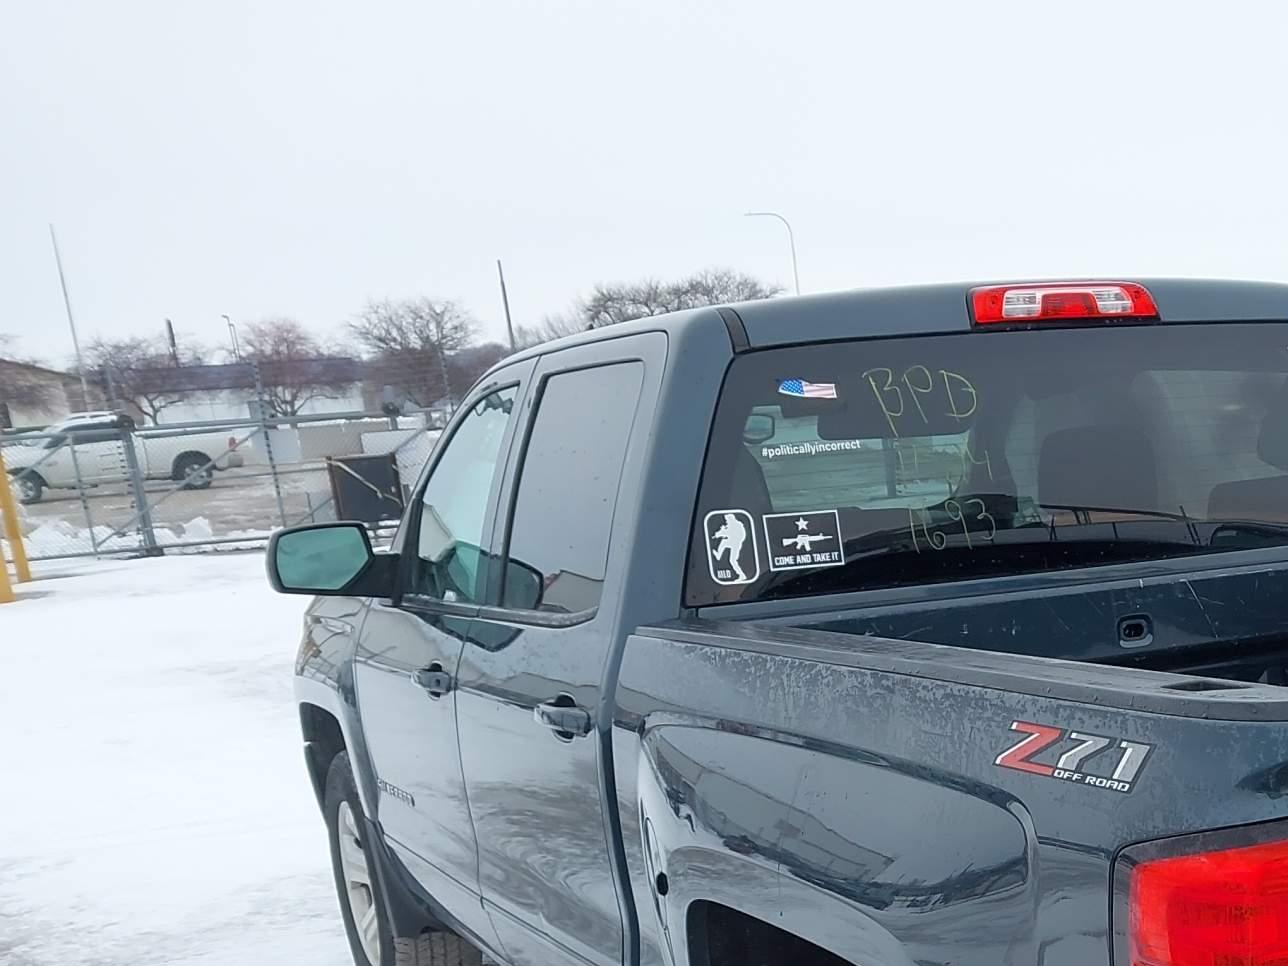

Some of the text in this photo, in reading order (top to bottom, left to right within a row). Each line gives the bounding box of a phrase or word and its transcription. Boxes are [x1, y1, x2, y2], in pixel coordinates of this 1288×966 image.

[861, 364, 977, 440] BPD
[761, 440, 861, 458] #politicallyincorrect
[909, 498, 996, 554] 1693
[774, 551, 839, 566] COME AND TAKE IT
[993, 720, 1157, 784] Z71
[1053, 769, 1130, 792] OFF ROAD
